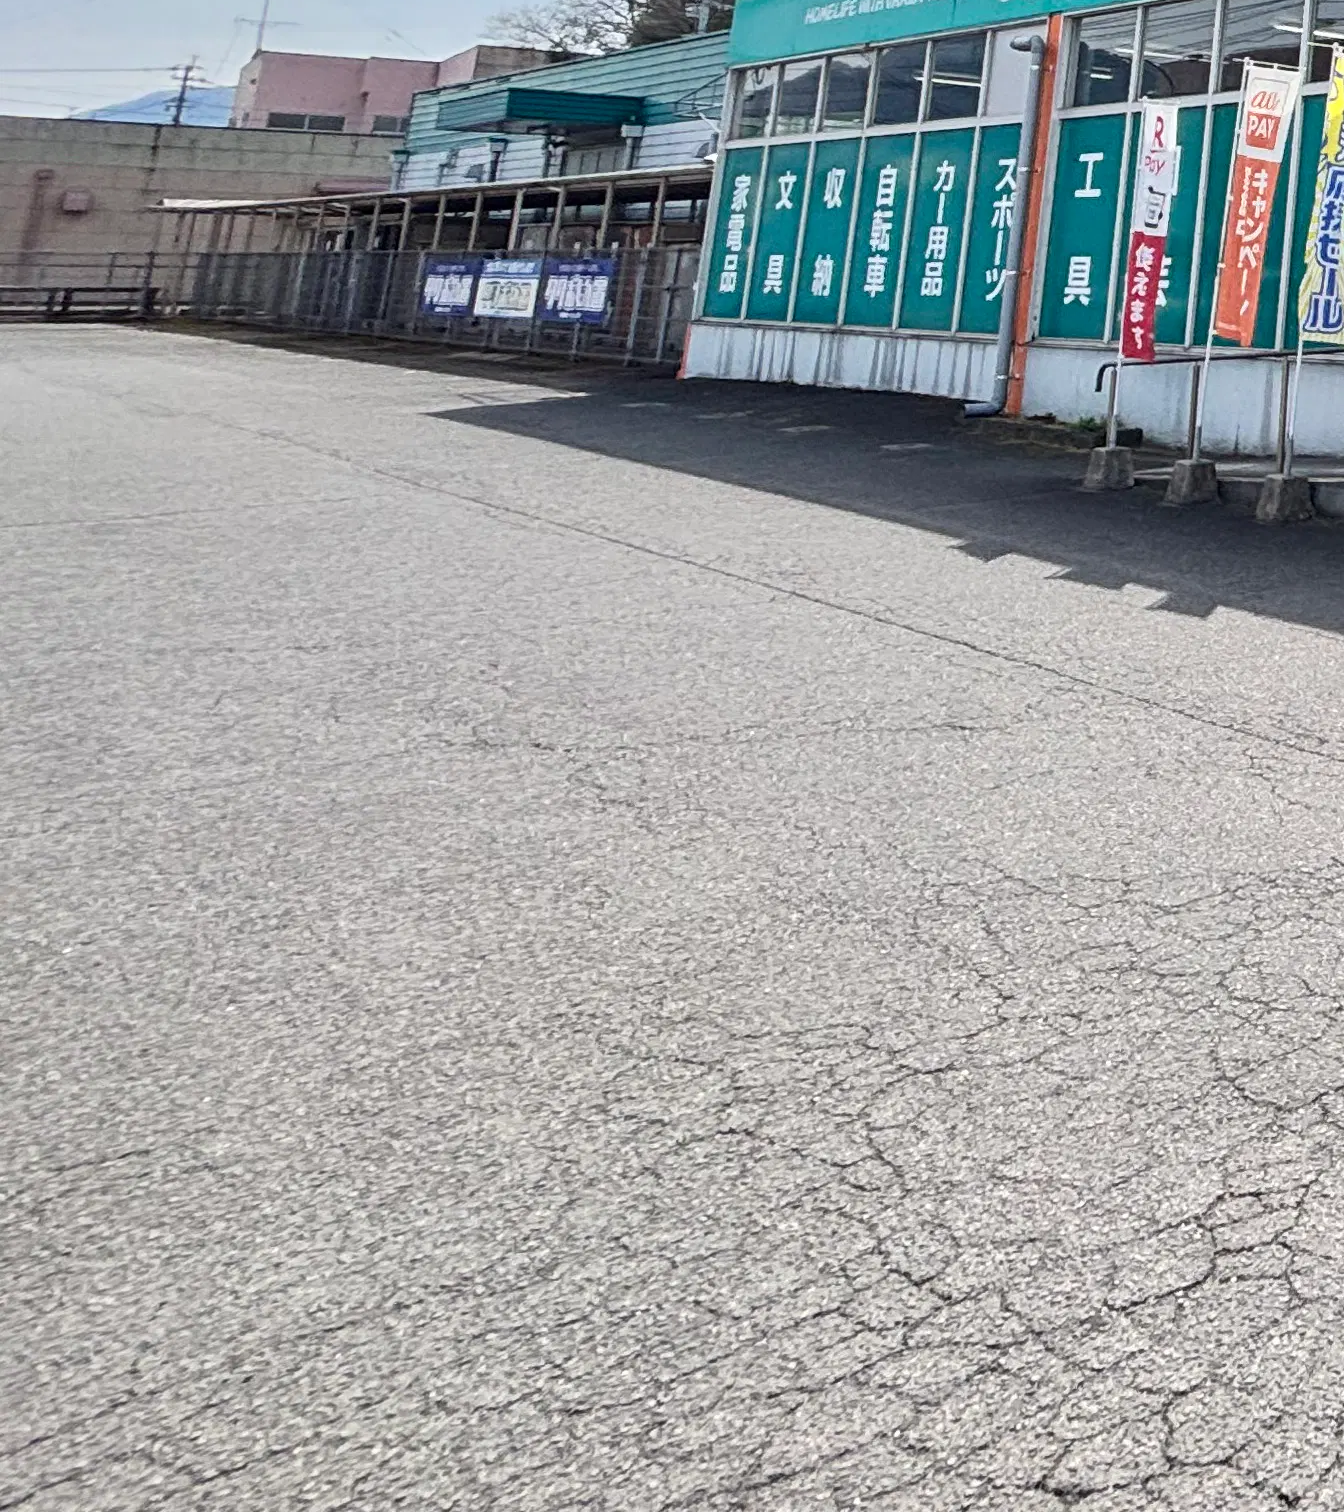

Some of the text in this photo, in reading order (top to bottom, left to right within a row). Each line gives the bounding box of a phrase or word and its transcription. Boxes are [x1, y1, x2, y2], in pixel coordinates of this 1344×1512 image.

[1248, 115, 1275, 139] PAY
[719, 174, 751, 293] 家電品
[763, 170, 797, 294] 文具
[864, 164, 897, 297] 自転車
[920, 159, 956, 296] カー用品
[985, 158, 1018, 301] スポーツ
[1063, 152, 1104, 306] 工具
